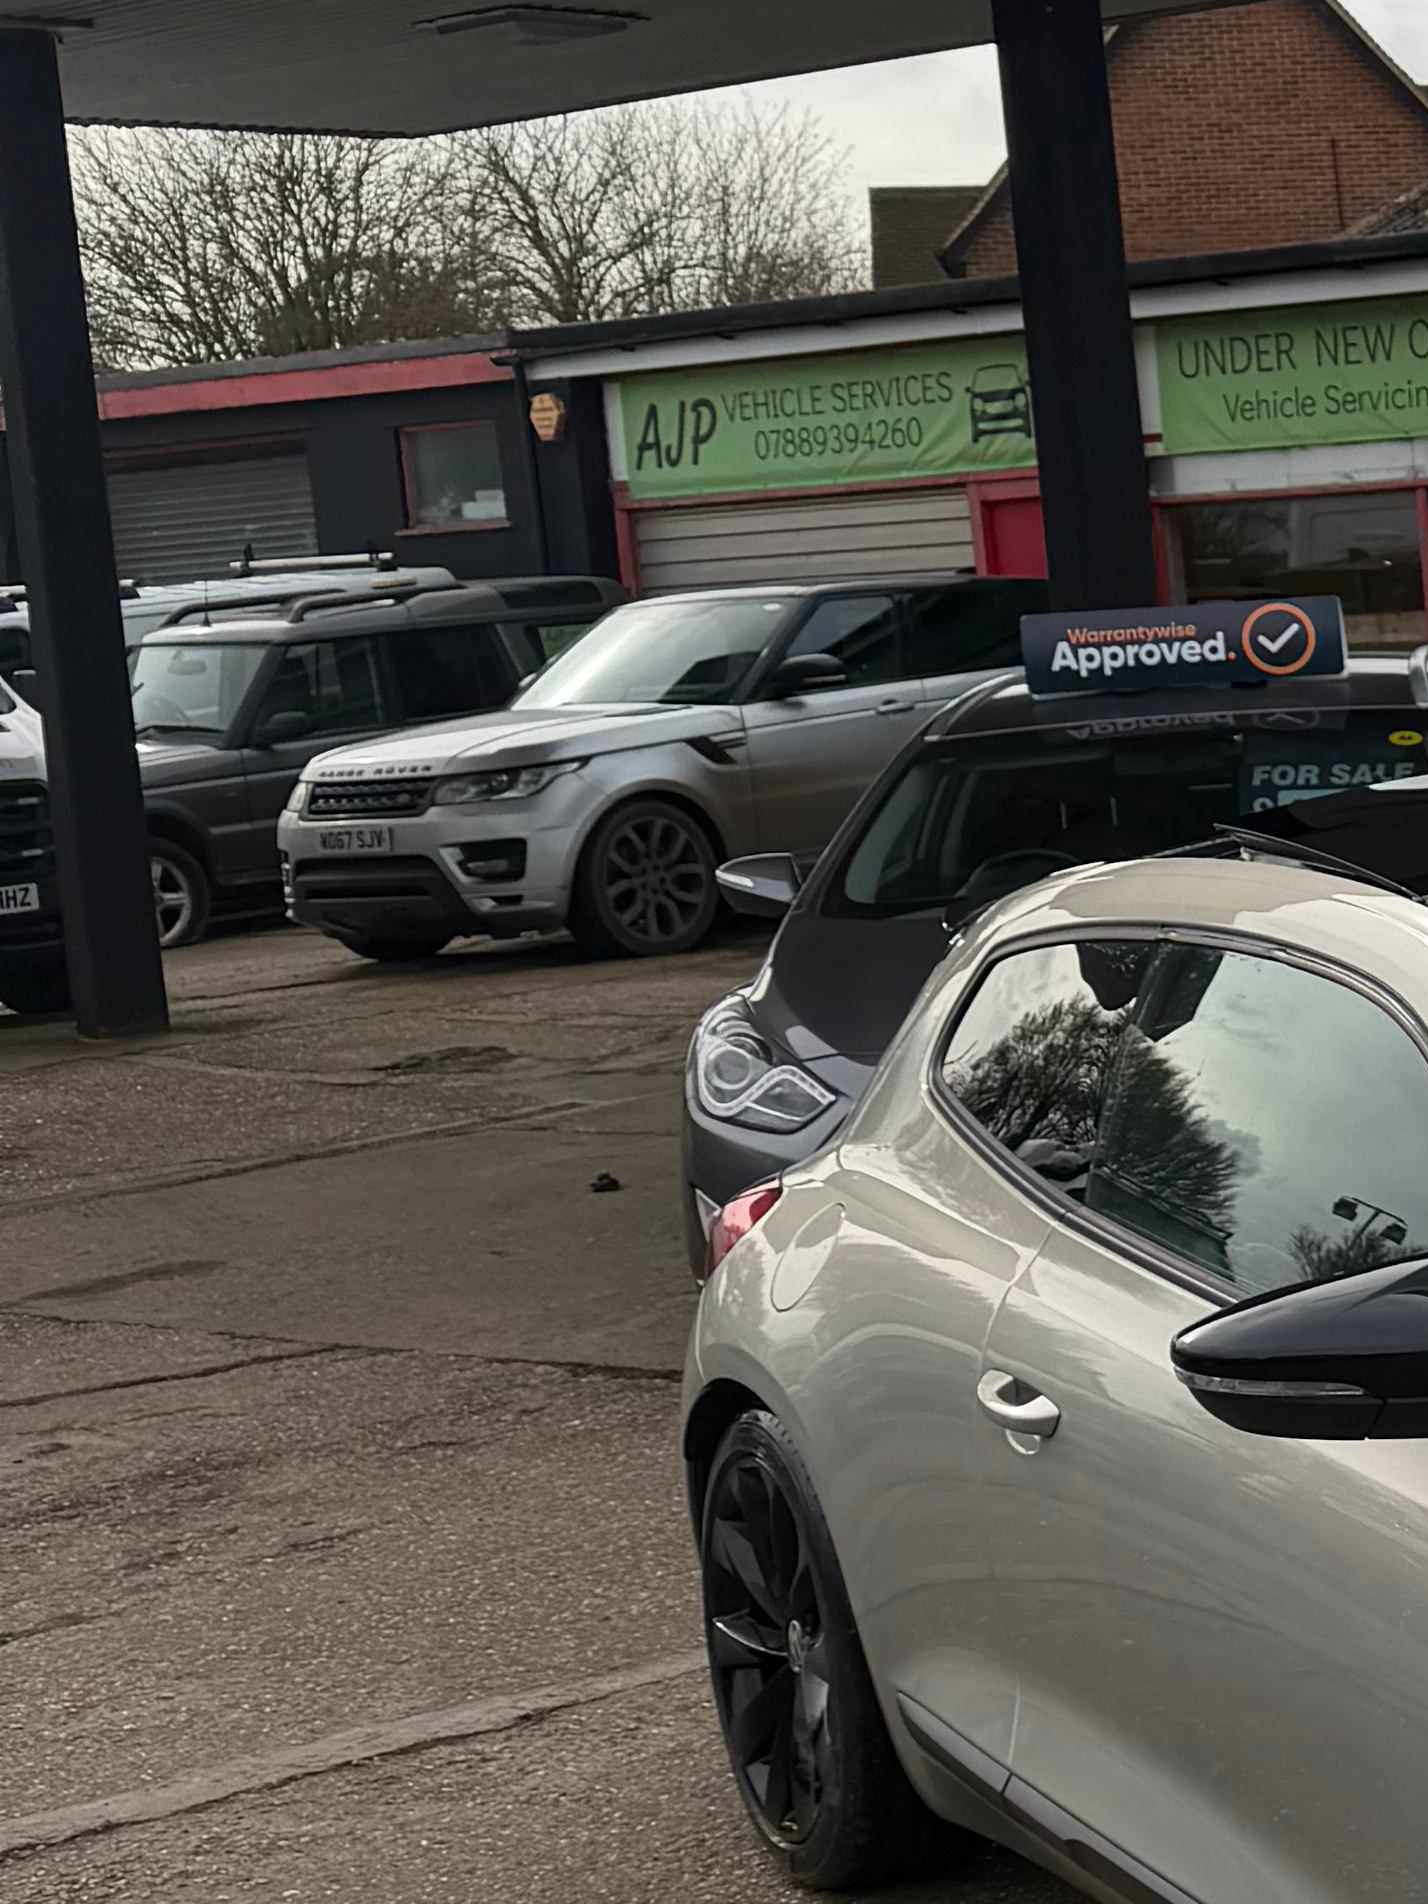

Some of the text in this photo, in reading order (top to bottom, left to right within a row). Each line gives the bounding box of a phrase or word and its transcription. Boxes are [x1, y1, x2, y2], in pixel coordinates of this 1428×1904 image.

[1177, 331, 1297, 379] UNDER
[1314, 322, 1395, 367] NEW
[721, 372, 953, 423] VEHICLE SERVICES
[1223, 386, 1316, 423] Vehicle
[636, 398, 717, 470] AJP
[754, 416, 923, 461] 07889394260
[1051, 631, 1236, 677] Approved.
[1067, 621, 1196, 645] Warrantywise
[1252, 762, 1415, 786] FOR SALE
